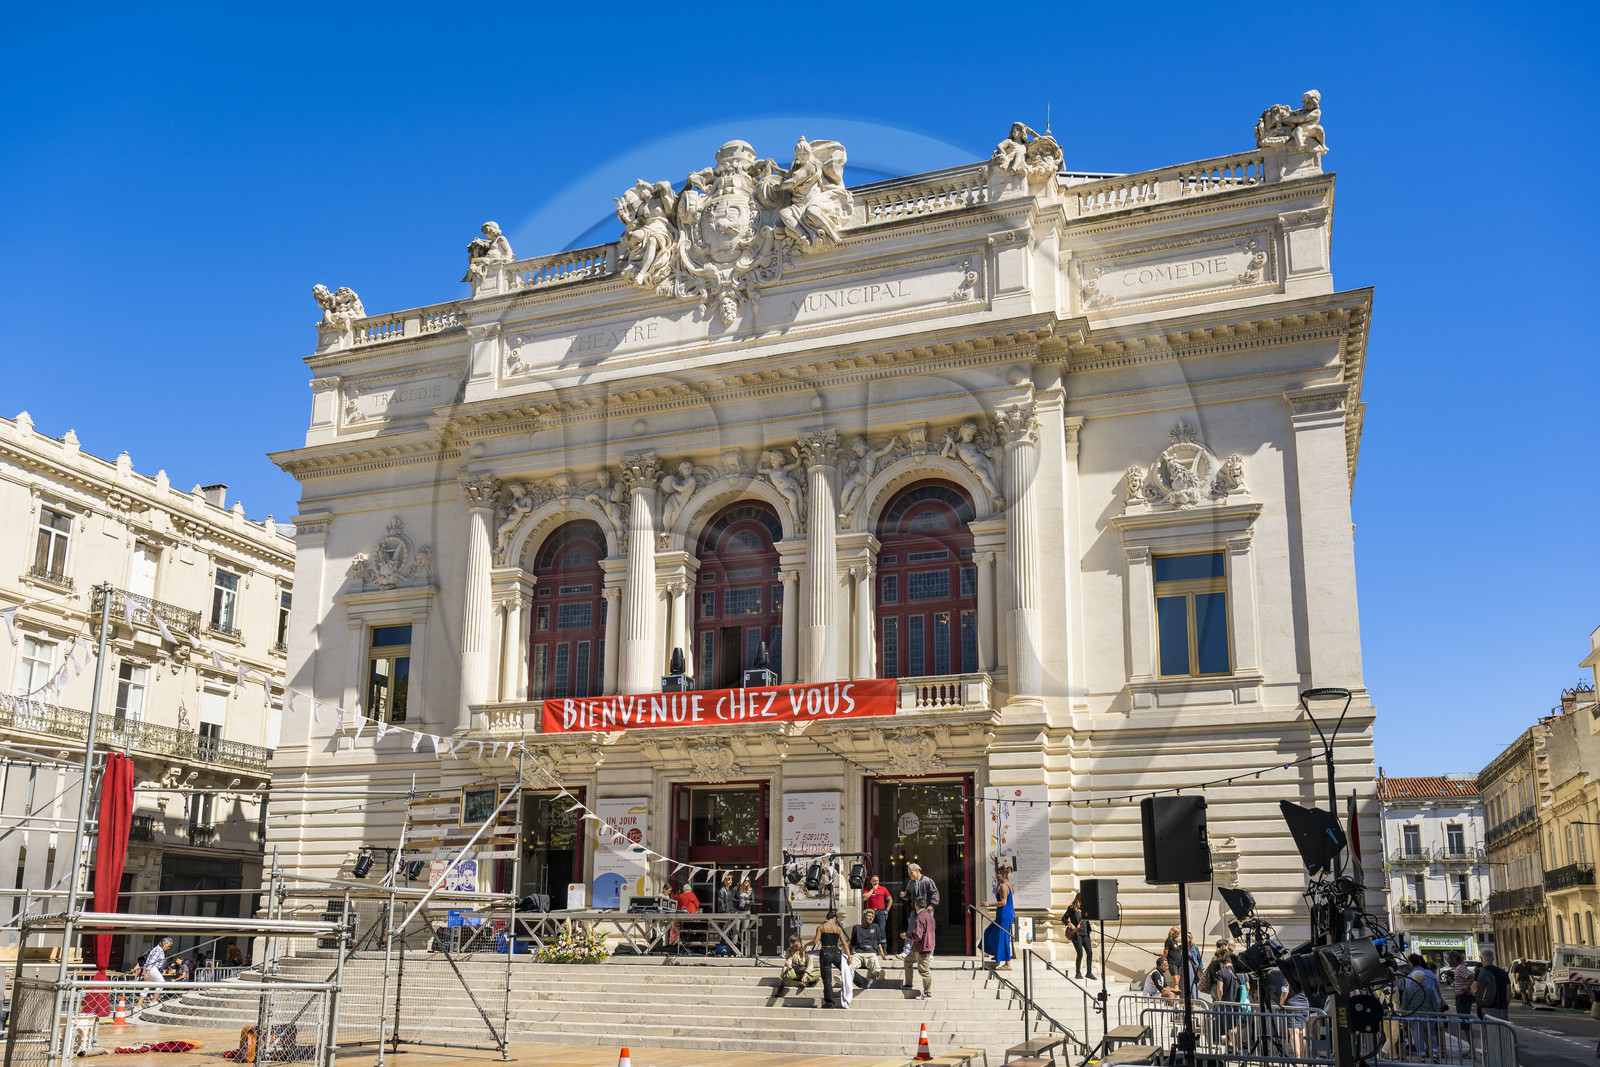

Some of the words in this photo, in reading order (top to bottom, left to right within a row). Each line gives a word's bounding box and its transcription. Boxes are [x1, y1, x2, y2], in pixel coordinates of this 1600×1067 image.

[1123, 258, 1228, 286] COMEDIE
[566, 322, 659, 352] THEATRE
[789, 280, 911, 315] MUNICIPAL
[372, 384, 441, 406] TRAGEDIE
[563, 694, 704, 730] BIENVENUE
[716, 688, 778, 720] CHEZ
[788, 683, 855, 716] VOUS
[606, 816, 616, 825] UN
[619, 816, 637, 825] JOUR
[900, 816, 920, 830] TMS
[613, 836, 624, 845] AU
[795, 831, 801, 841] 7
